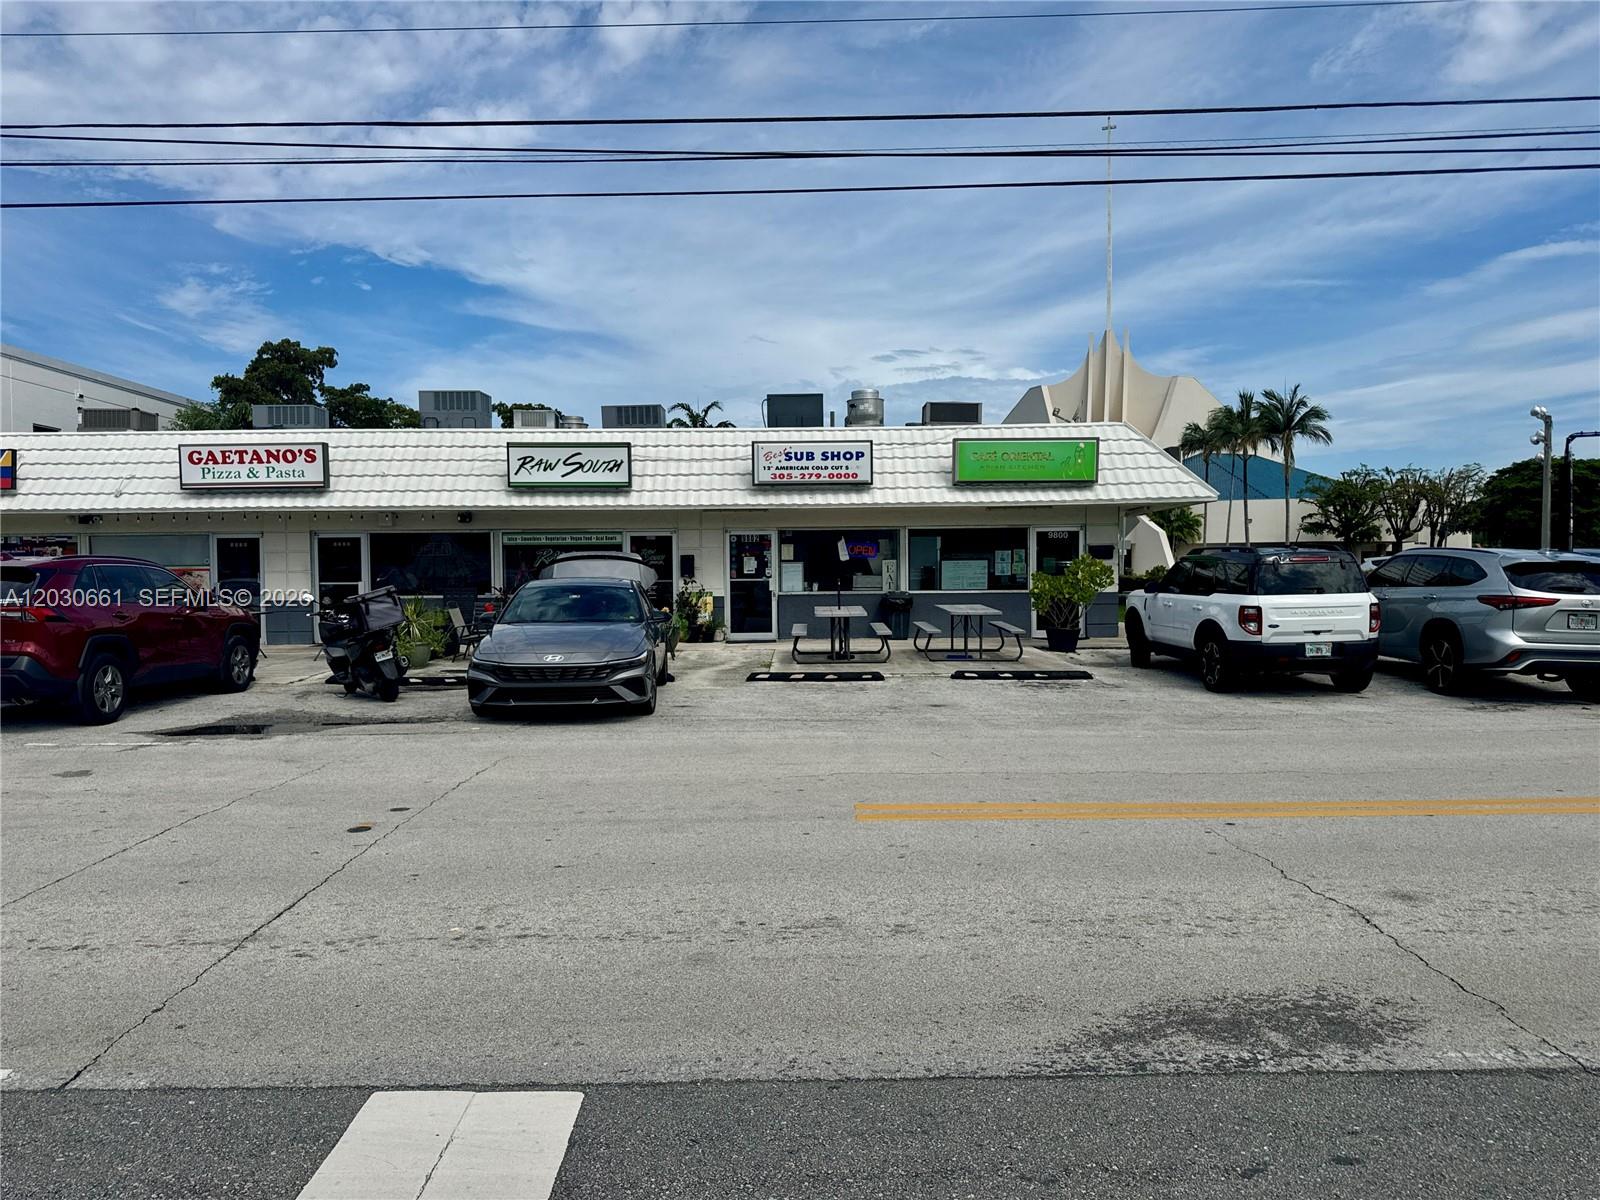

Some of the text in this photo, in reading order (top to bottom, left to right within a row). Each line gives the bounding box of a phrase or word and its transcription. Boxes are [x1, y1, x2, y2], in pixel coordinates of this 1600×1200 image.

[187, 448, 317, 465] GAETANO'S
[763, 447, 865, 462] Best SUB SHOP
[201, 466, 305, 479] Pizza & Pasta
[770, 472, 858, 480] 305-279-0000
[1047, 531, 1069, 539] 9800
[848, 545, 875, 556] OPEN
